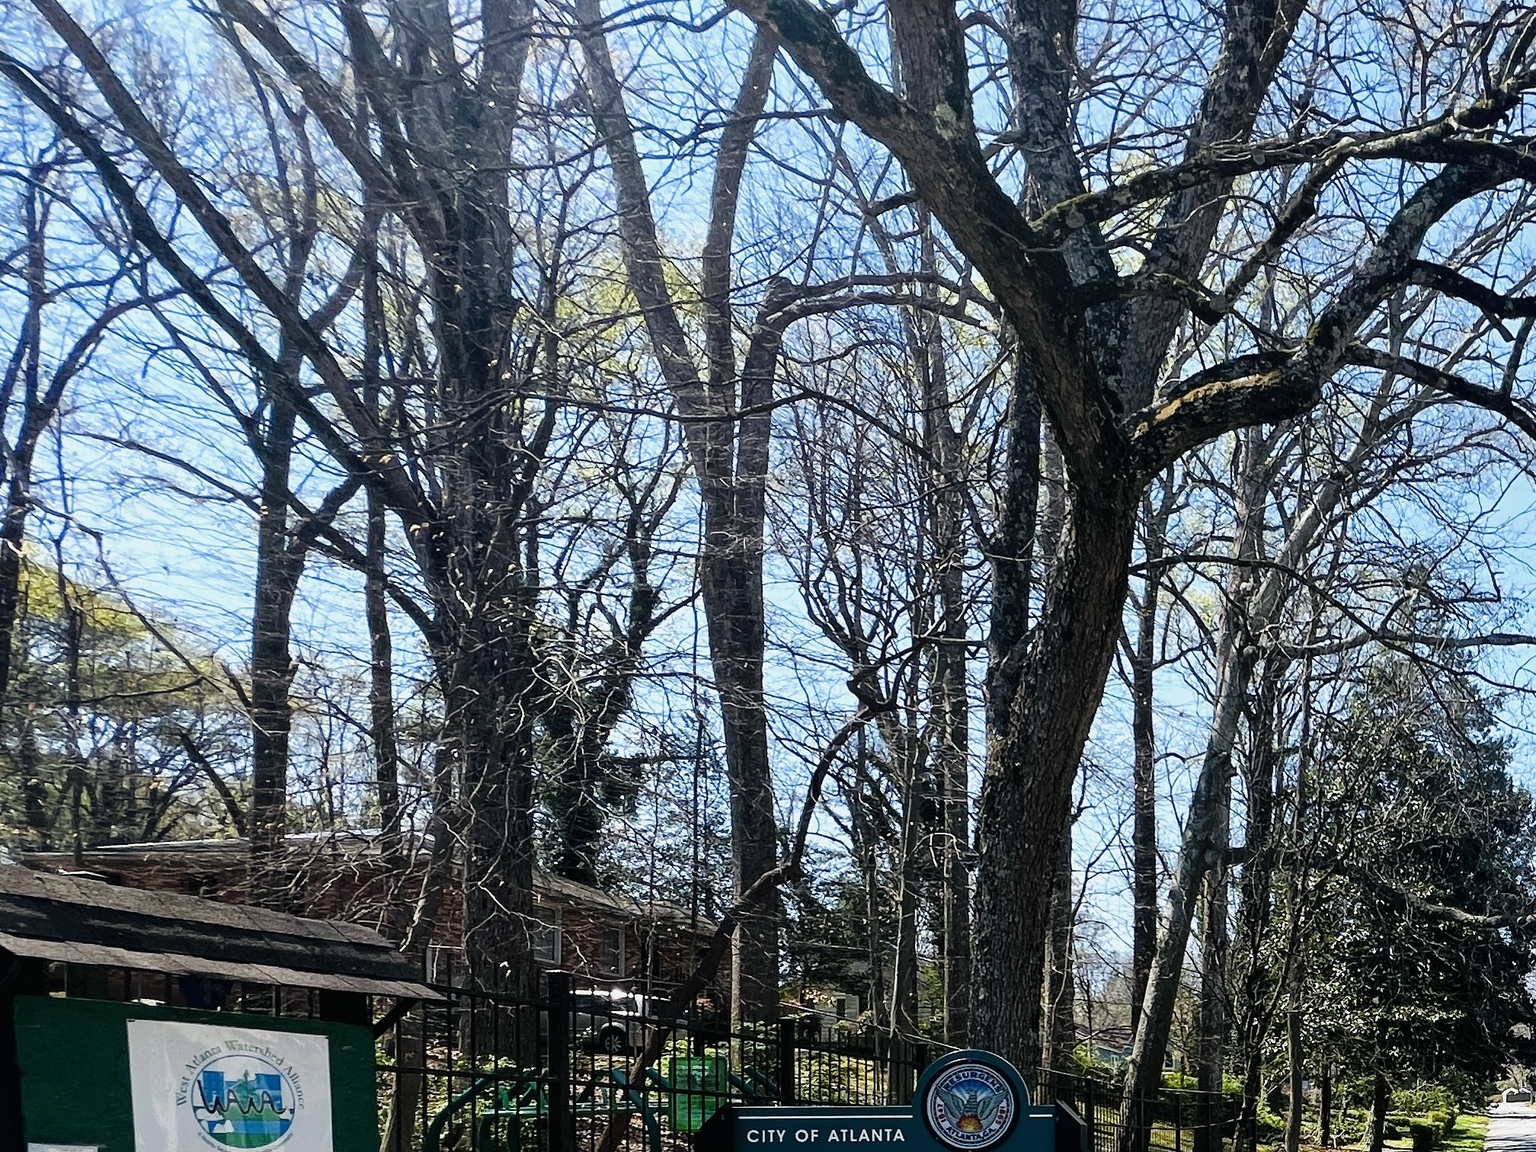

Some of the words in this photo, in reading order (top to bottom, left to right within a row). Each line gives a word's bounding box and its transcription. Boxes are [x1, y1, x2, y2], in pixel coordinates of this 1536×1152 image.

[176, 1076, 192, 1107] West
[185, 1045, 223, 1075] Atlanta
[225, 1040, 286, 1067] Watershed
[284, 1066, 305, 1110] Alliance
[943, 1071, 1004, 1093] RESURGENS
[936, 1103, 947, 1123] 1847
[747, 1129, 786, 1143] CITY
[795, 1129, 819, 1143] OF
[827, 1128, 905, 1142] ATLANTA
